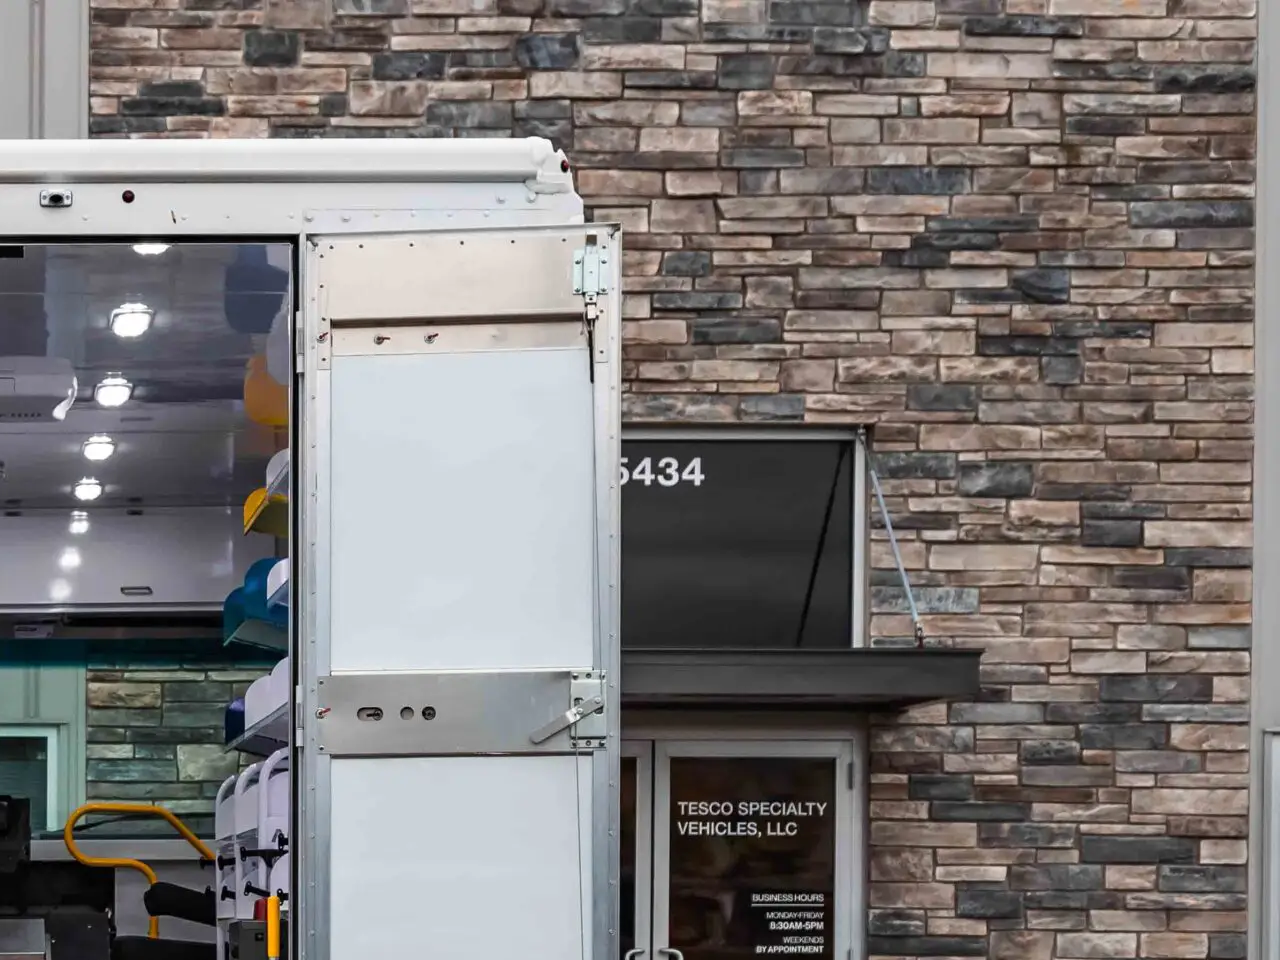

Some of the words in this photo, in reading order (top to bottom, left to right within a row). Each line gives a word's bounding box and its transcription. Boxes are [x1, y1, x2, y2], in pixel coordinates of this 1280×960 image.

[677, 801, 734, 816] TESCO
[738, 801, 827, 816] SPECIALTY
[677, 821, 762, 838] VEHICLES,
[766, 821, 798, 836] LLC
[751, 893, 793, 902] BUSINESS
[794, 893, 824, 902] HOURS
[769, 921, 824, 930] 8:30AM-5PM
[782, 936, 824, 944] WEEKENDS
[756, 945, 767, 953] BY
[767, 945, 824, 953] APPOINTMENT
